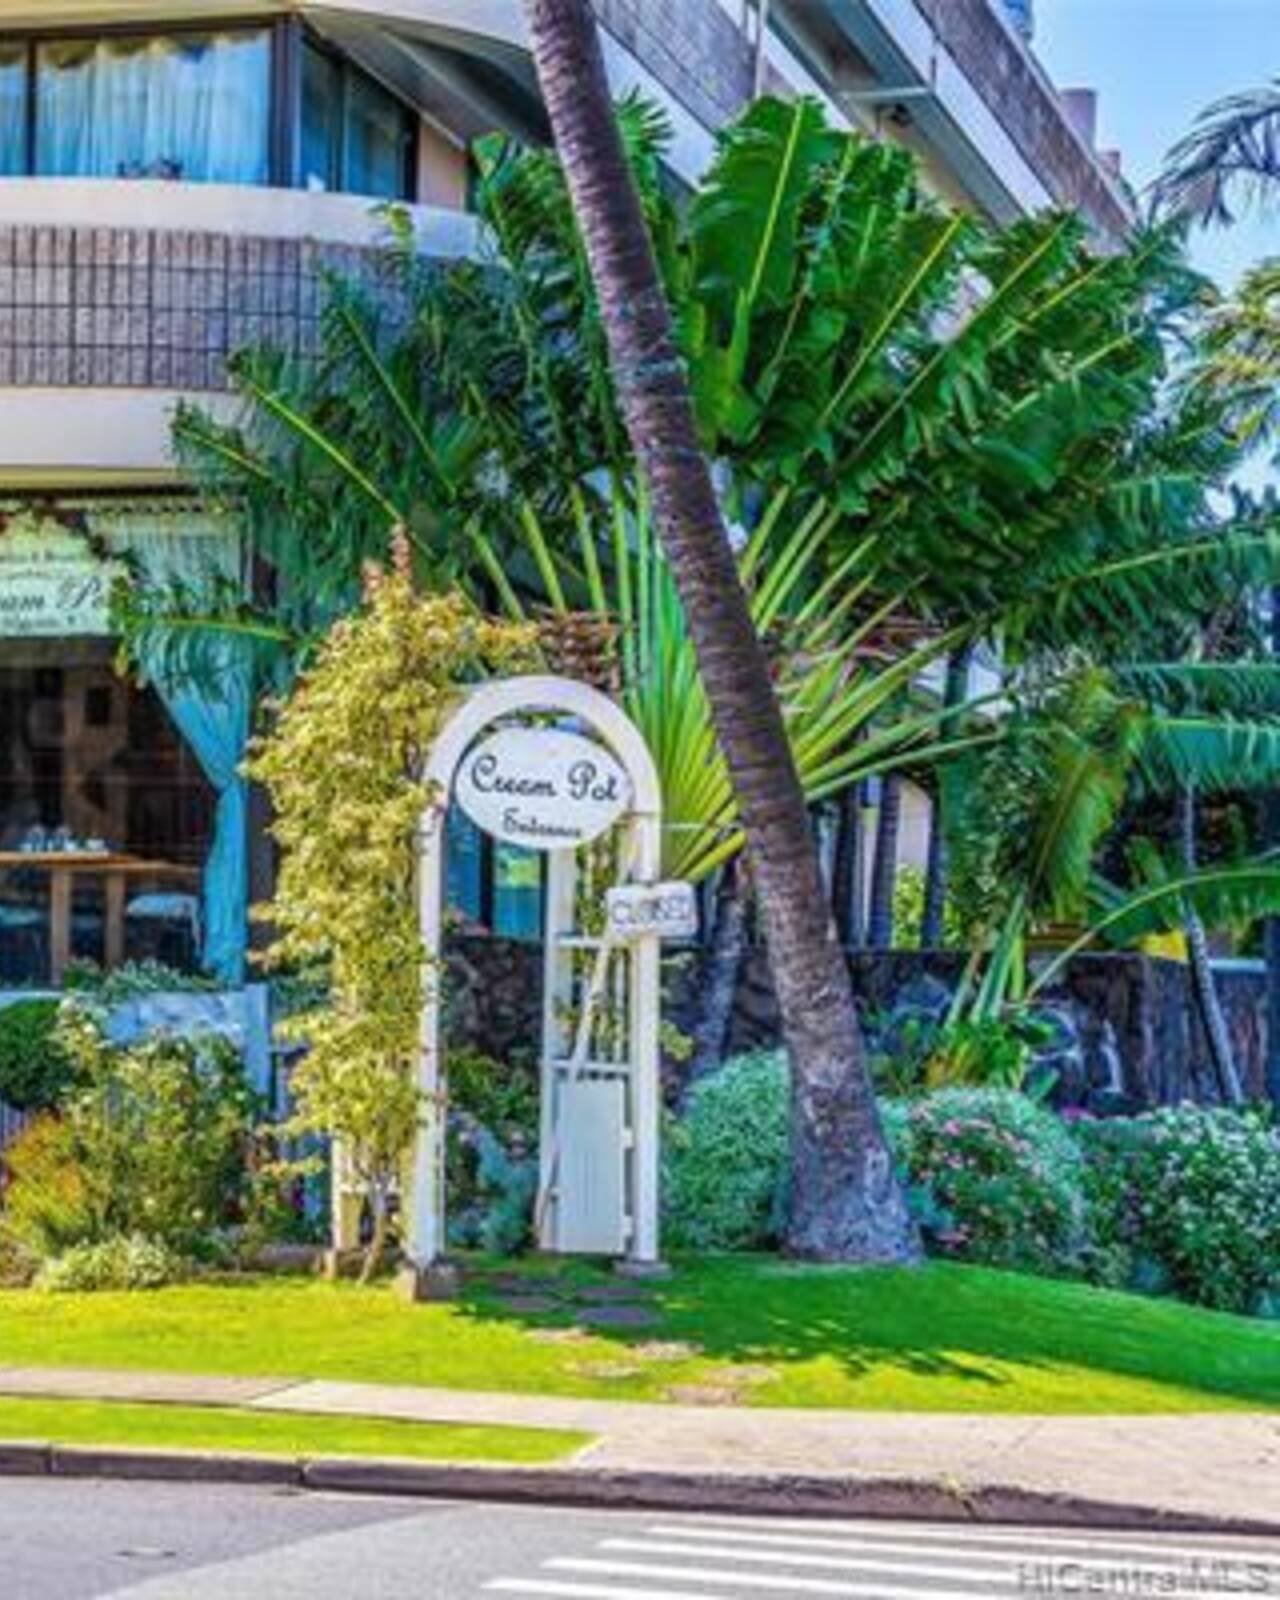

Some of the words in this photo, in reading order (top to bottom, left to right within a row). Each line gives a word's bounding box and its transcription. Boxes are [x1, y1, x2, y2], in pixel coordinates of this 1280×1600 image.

[470, 753, 558, 797] Cream
[567, 759, 619, 801] Pot
[501, 806, 583, 838] Entrance
